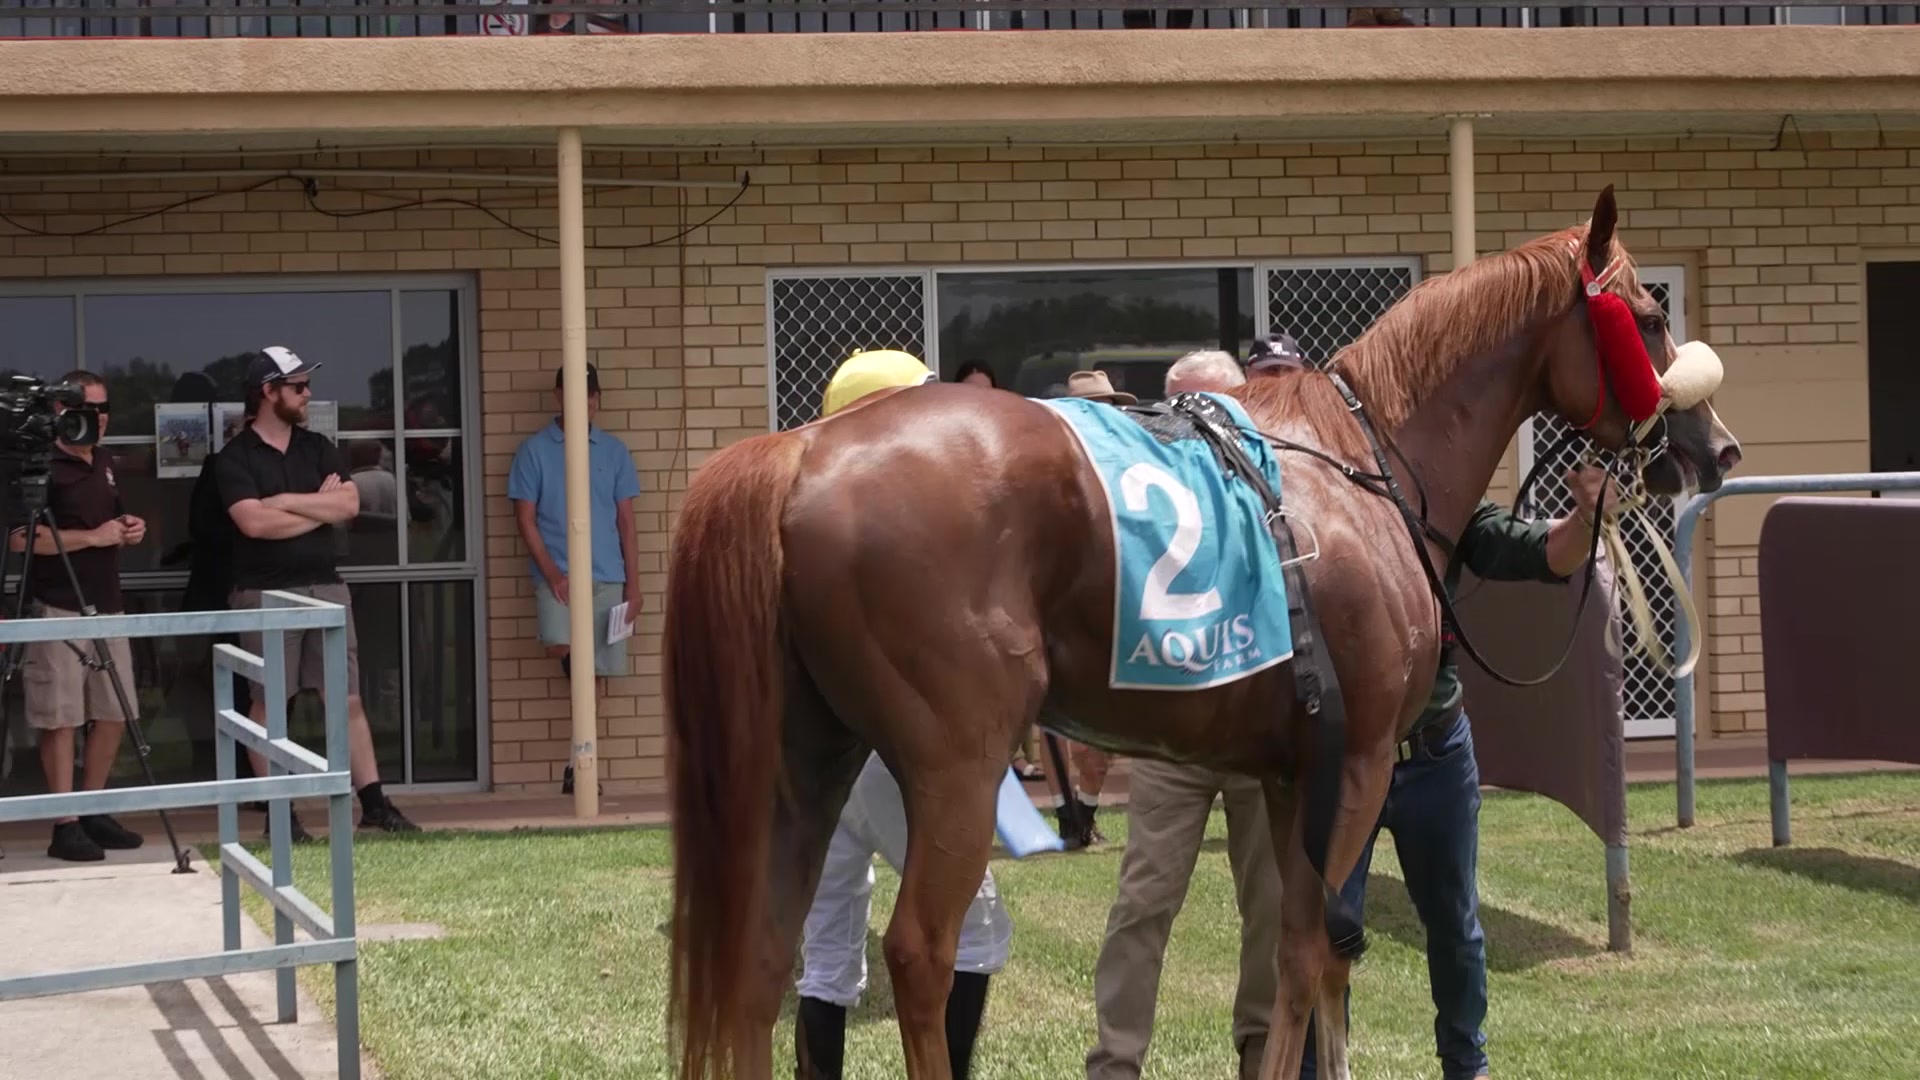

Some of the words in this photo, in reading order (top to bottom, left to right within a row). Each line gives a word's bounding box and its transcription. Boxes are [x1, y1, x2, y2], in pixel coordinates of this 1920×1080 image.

[1120, 462, 1223, 621] 2
[1127, 613, 1255, 673] AQUIS
[1213, 646, 1262, 672] FARM
